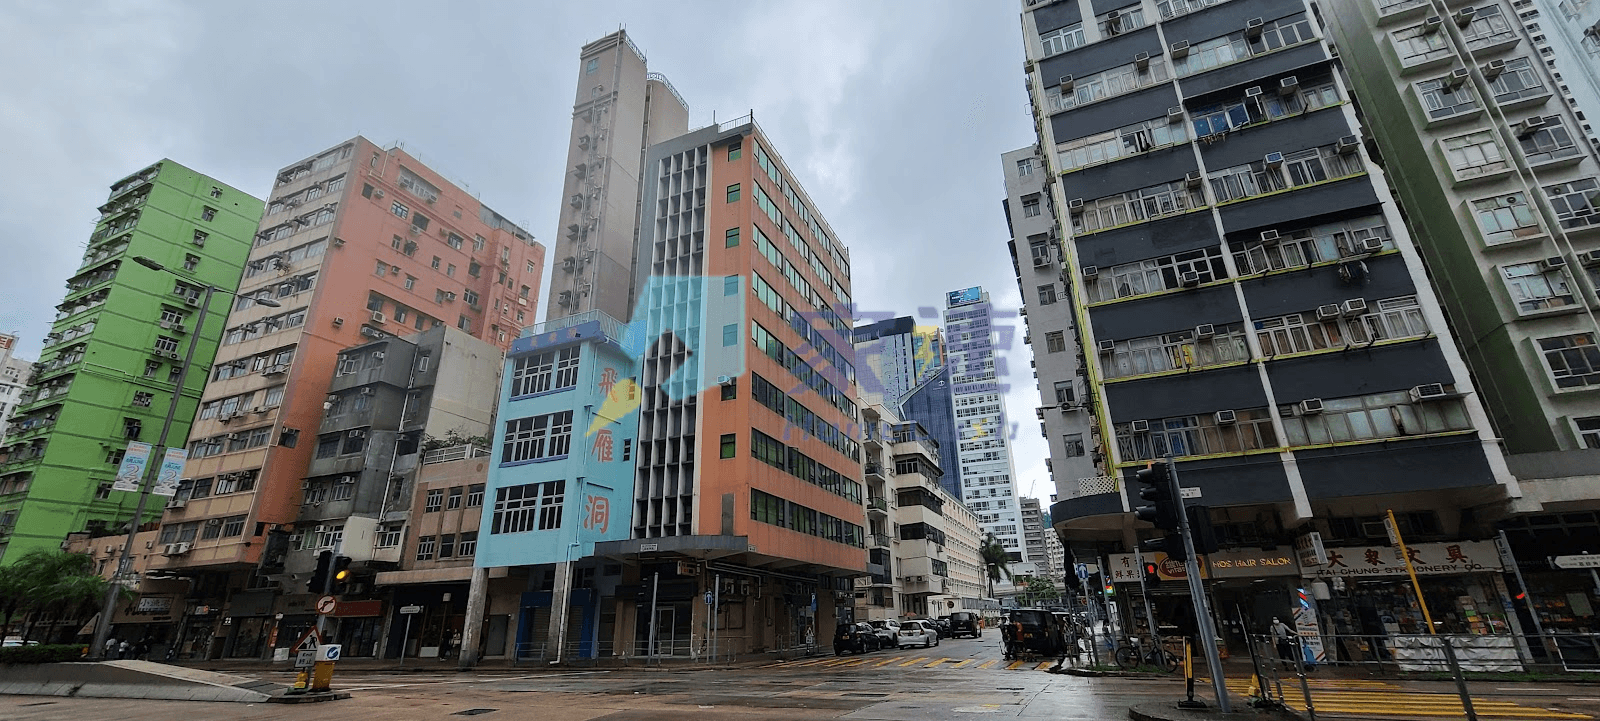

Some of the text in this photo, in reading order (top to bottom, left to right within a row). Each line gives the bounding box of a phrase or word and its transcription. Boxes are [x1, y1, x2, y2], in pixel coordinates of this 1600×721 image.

[1260, 557, 1291, 566] SALON
[1340, 567, 1379, 575] CHUNG
[1384, 564, 1457, 574] STAIONERY
